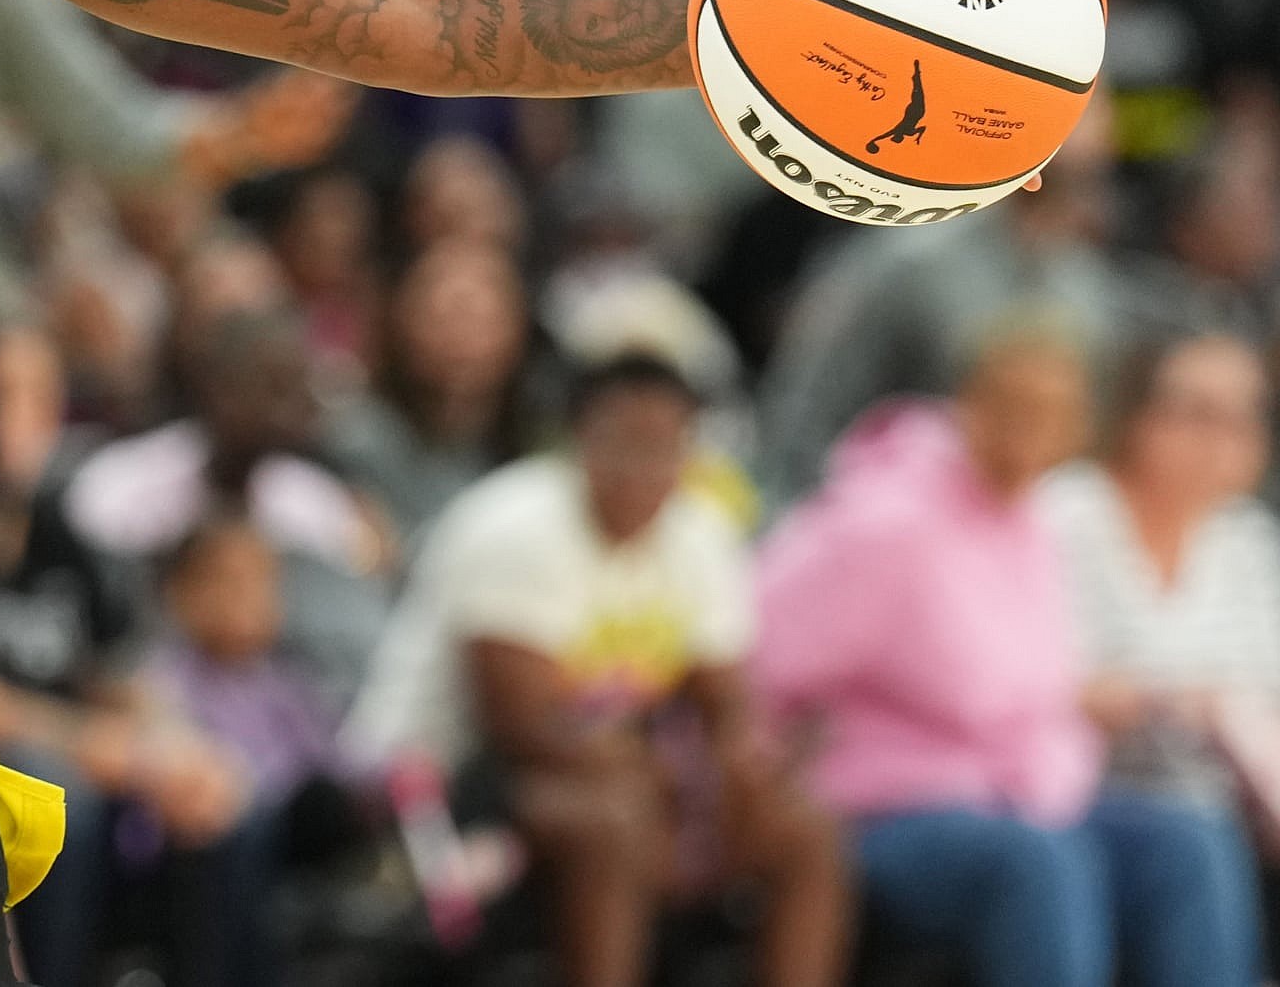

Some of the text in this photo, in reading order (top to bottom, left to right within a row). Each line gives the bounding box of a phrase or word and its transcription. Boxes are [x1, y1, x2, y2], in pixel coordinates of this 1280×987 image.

[951, 110, 1025, 130] GAME BALL
[956, 123, 1012, 140] OFFICIAL
